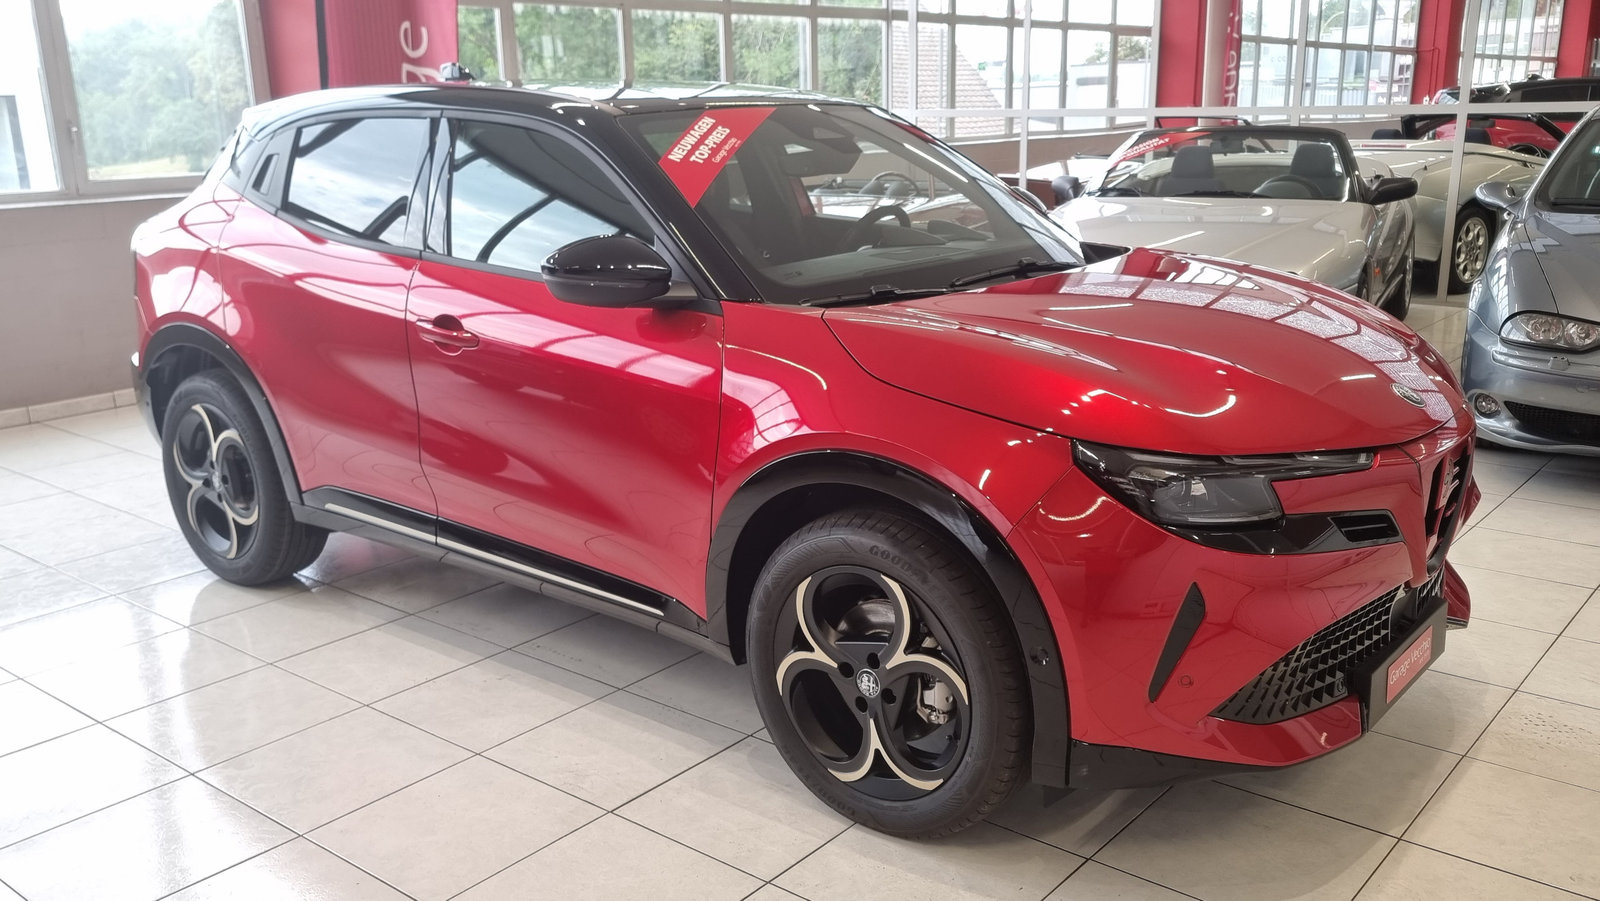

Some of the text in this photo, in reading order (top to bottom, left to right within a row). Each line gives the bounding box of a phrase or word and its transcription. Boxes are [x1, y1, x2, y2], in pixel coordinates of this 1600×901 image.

[667, 116, 716, 162] NEUWAGEN
[689, 125, 731, 164] TOP-PREIS
[1390, 659, 1411, 685] Garage
